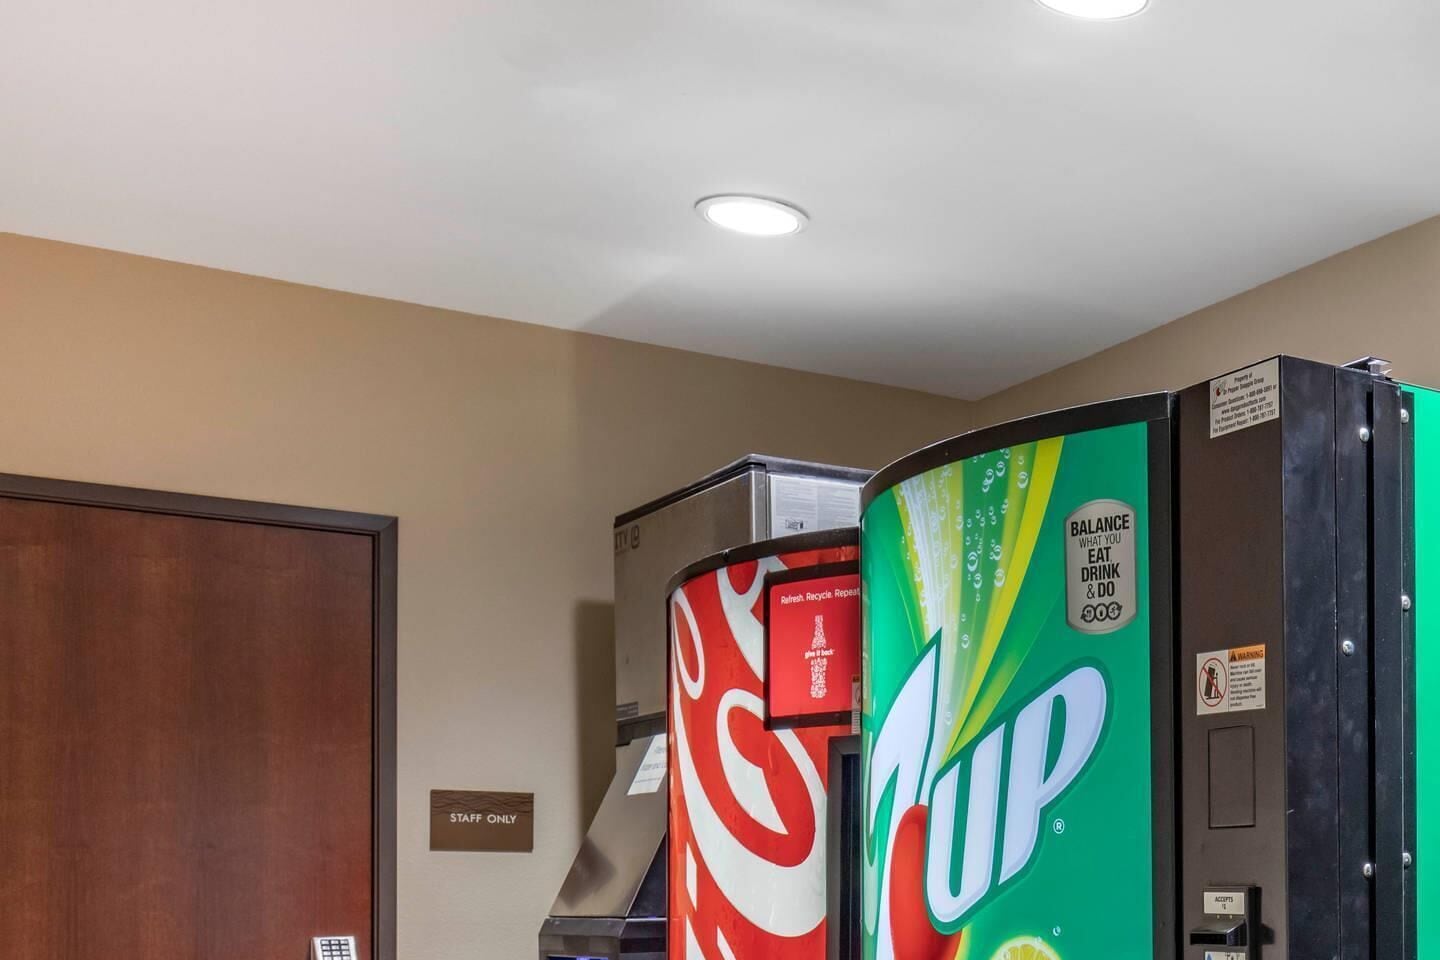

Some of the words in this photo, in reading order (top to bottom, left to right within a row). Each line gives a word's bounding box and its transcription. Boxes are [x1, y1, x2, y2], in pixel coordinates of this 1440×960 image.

[1071, 514, 1130, 537] BALANCE
[1079, 535, 1103, 548] WHAT
[1104, 532, 1121, 545] YOU
[1081, 563, 1120, 582] DRINK
[780, 594, 805, 604] Refresh.
[806, 591, 833, 602] Recycle.
[1086, 583, 1096, 600] &
[1097, 581, 1115, 598] DO
[450, 813, 482, 823] STAFF
[487, 814, 517, 824] ONLY
